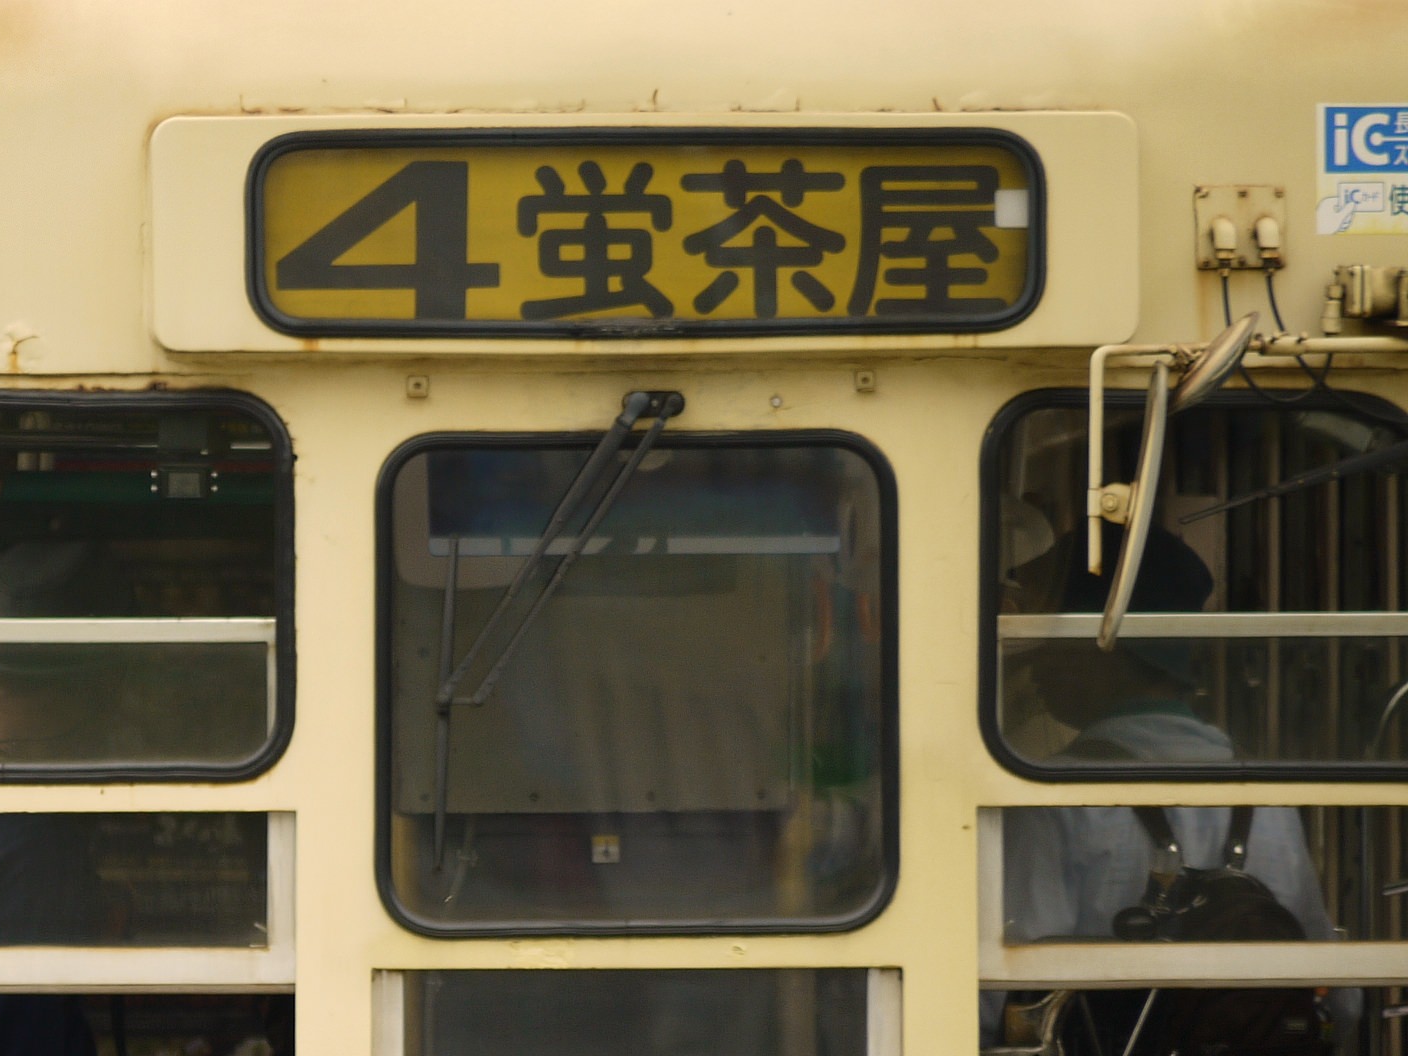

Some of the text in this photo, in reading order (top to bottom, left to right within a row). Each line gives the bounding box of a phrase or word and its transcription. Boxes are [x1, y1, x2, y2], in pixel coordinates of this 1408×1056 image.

[275, 158, 1008, 319] 4 蛍茶屋
